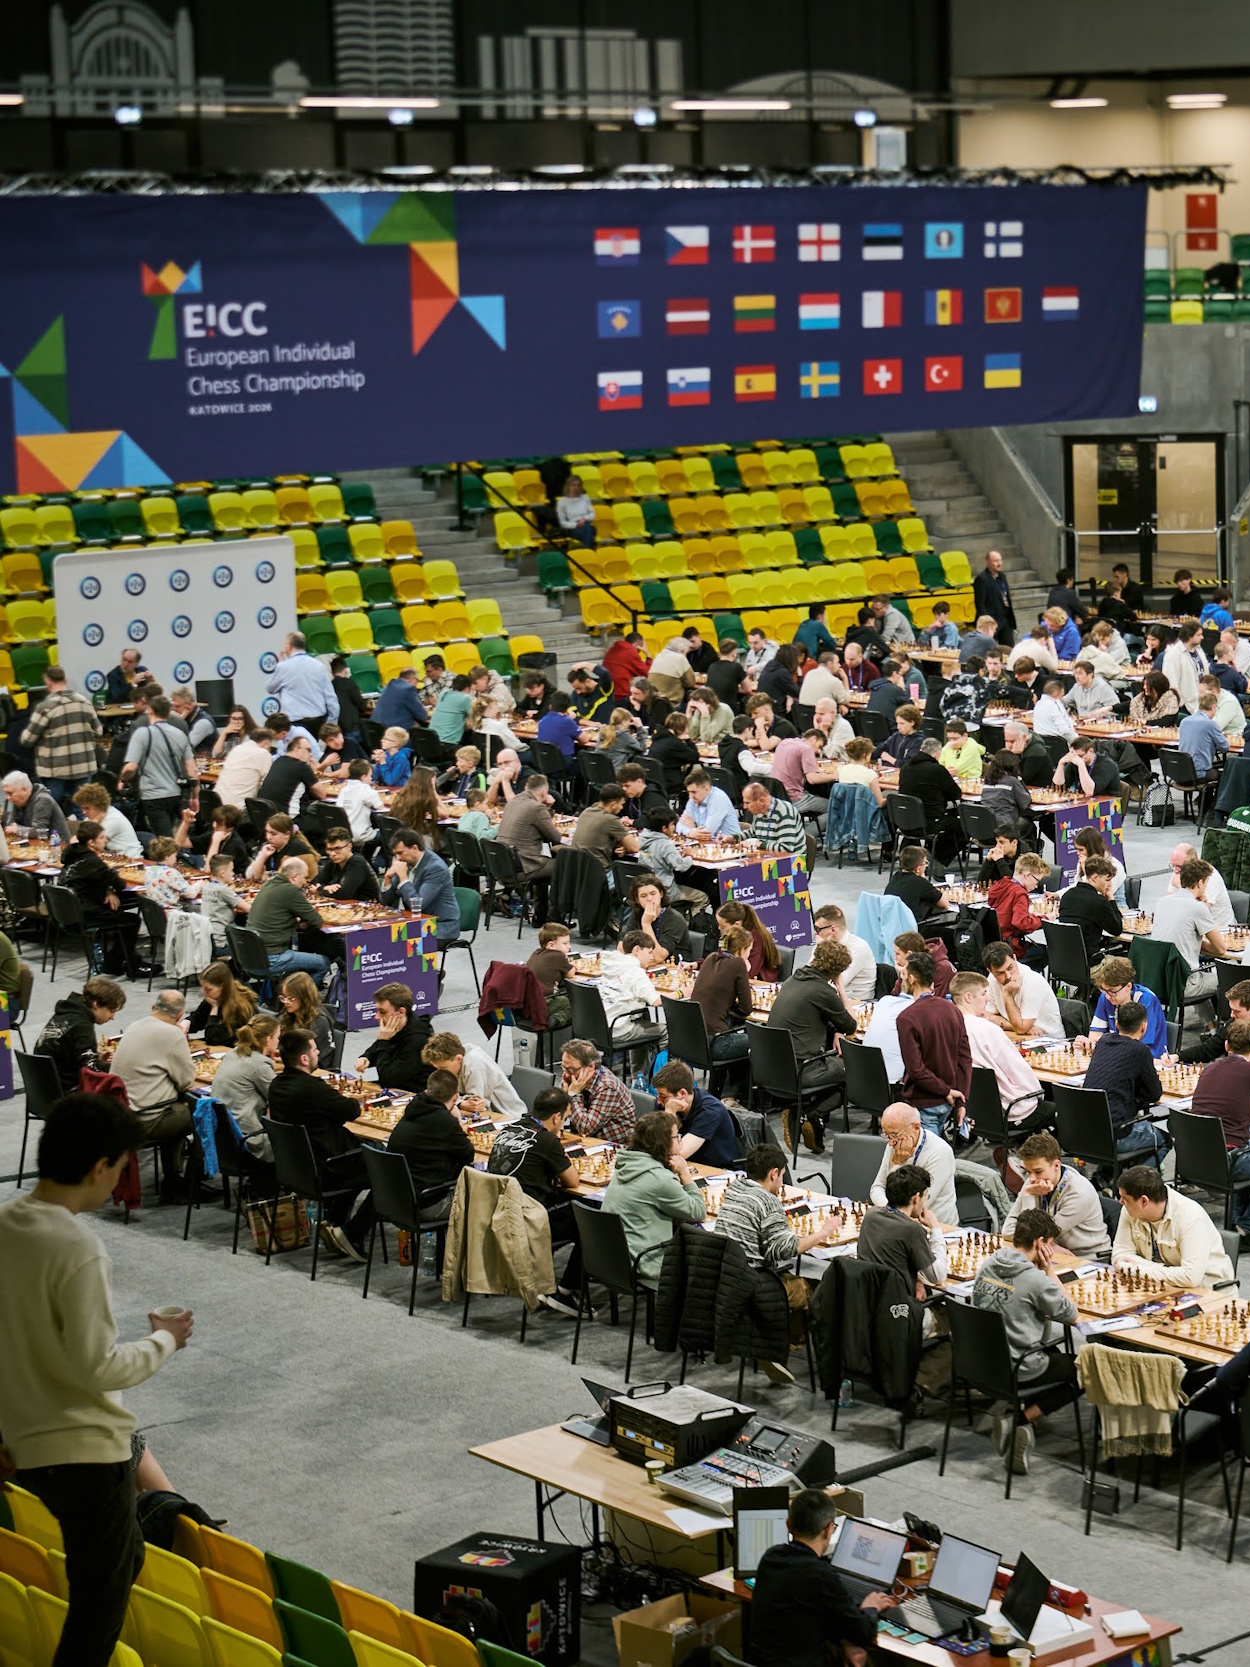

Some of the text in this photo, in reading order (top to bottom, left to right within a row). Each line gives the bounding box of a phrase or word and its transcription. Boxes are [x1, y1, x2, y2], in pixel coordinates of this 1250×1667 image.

[186, 341, 356, 369] European Individual
[188, 370, 366, 396] Chess Championship
[188, 403, 273, 415] KATOWICE 2026
